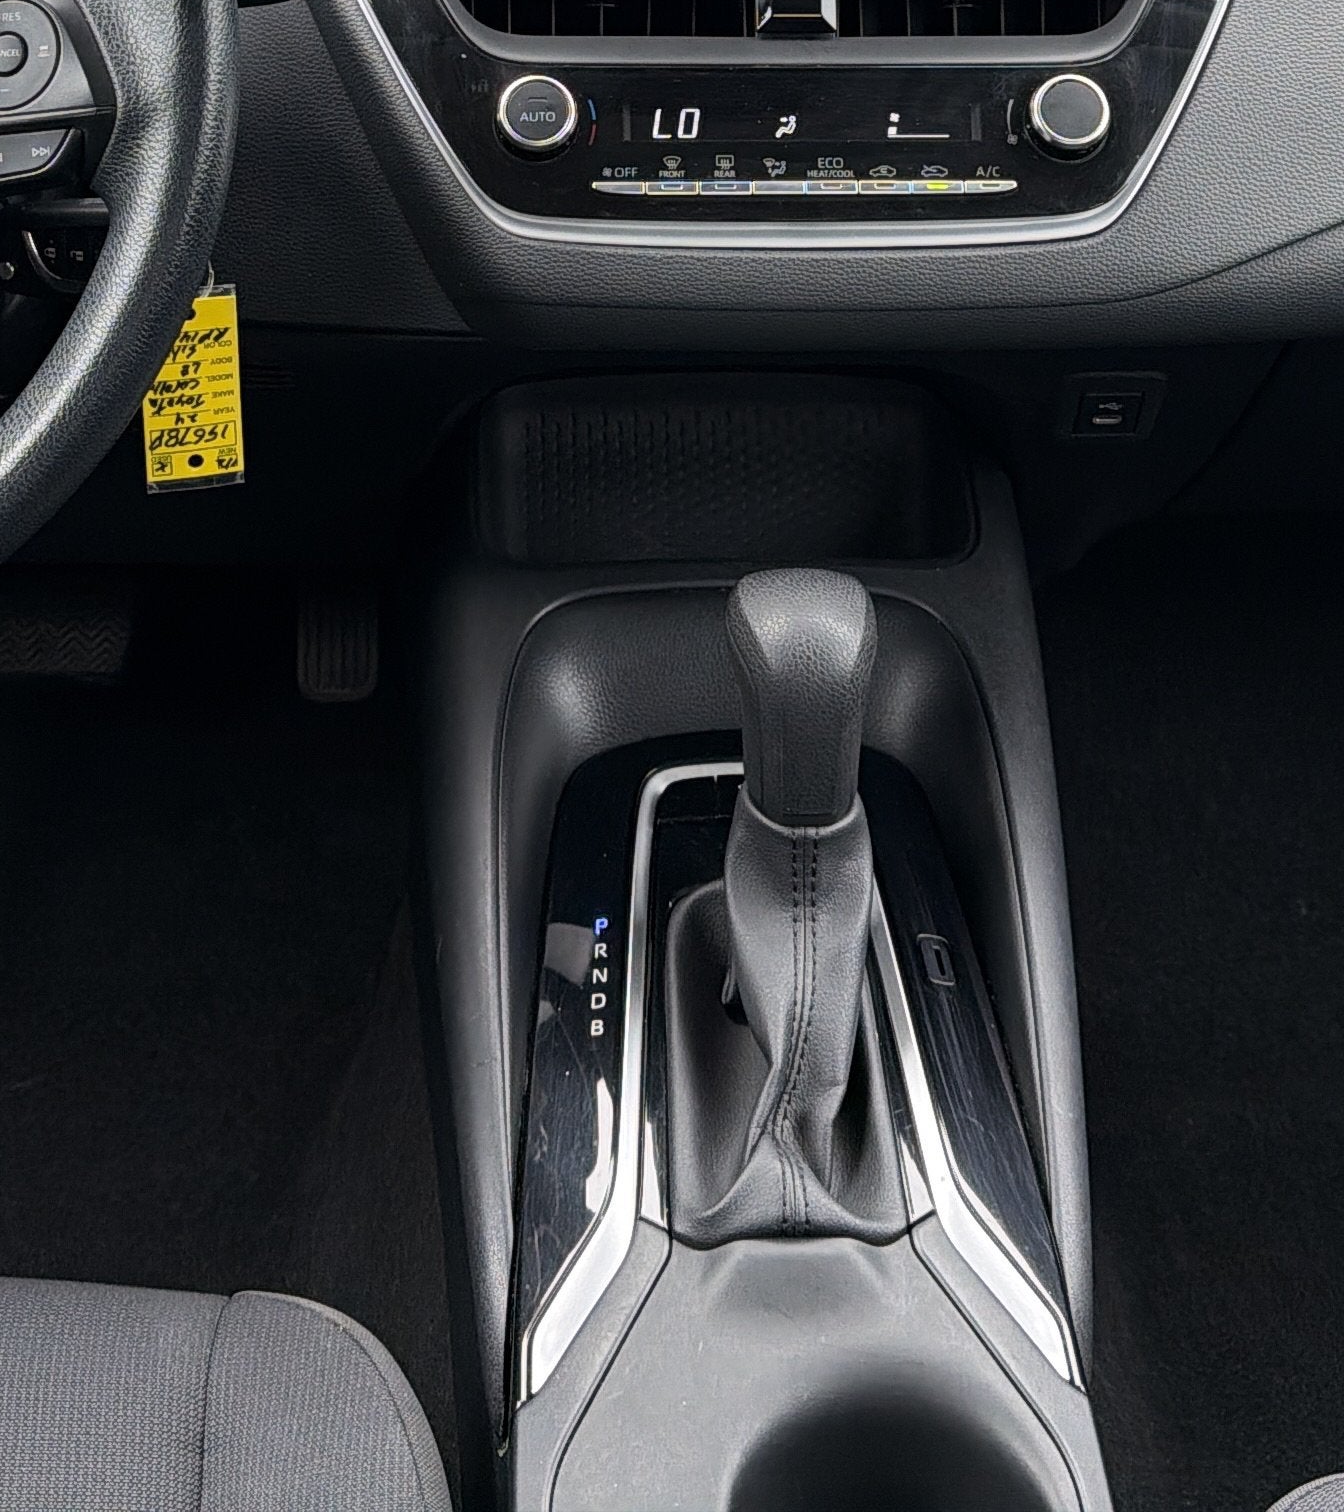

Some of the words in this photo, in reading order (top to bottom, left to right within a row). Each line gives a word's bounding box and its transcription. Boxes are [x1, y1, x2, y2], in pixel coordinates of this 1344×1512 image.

[520, 112, 556, 122] AUTO
[651, 107, 701, 140] LO
[817, 157, 844, 169] ECO
[614, 167, 639, 178] OFF
[659, 170, 686, 178] FRONT
[714, 170, 736, 178] REAR
[807, 169, 855, 178] HEAT/COOL
[976, 165, 1001, 178] A/C
[203, 339, 233, 350] COLOR
[210, 356, 233, 366] BODY
[207, 372, 234, 383] MODEL
[211, 389, 235, 399] MAKE
[213, 406, 235, 415] YEAR
[217, 447, 237, 455] NEW
[595, 917, 608, 936] P
[594, 943, 608, 959] R
[592, 967, 607, 985] N
[590, 993, 606, 1010] D
[590, 1019, 604, 1037] B
